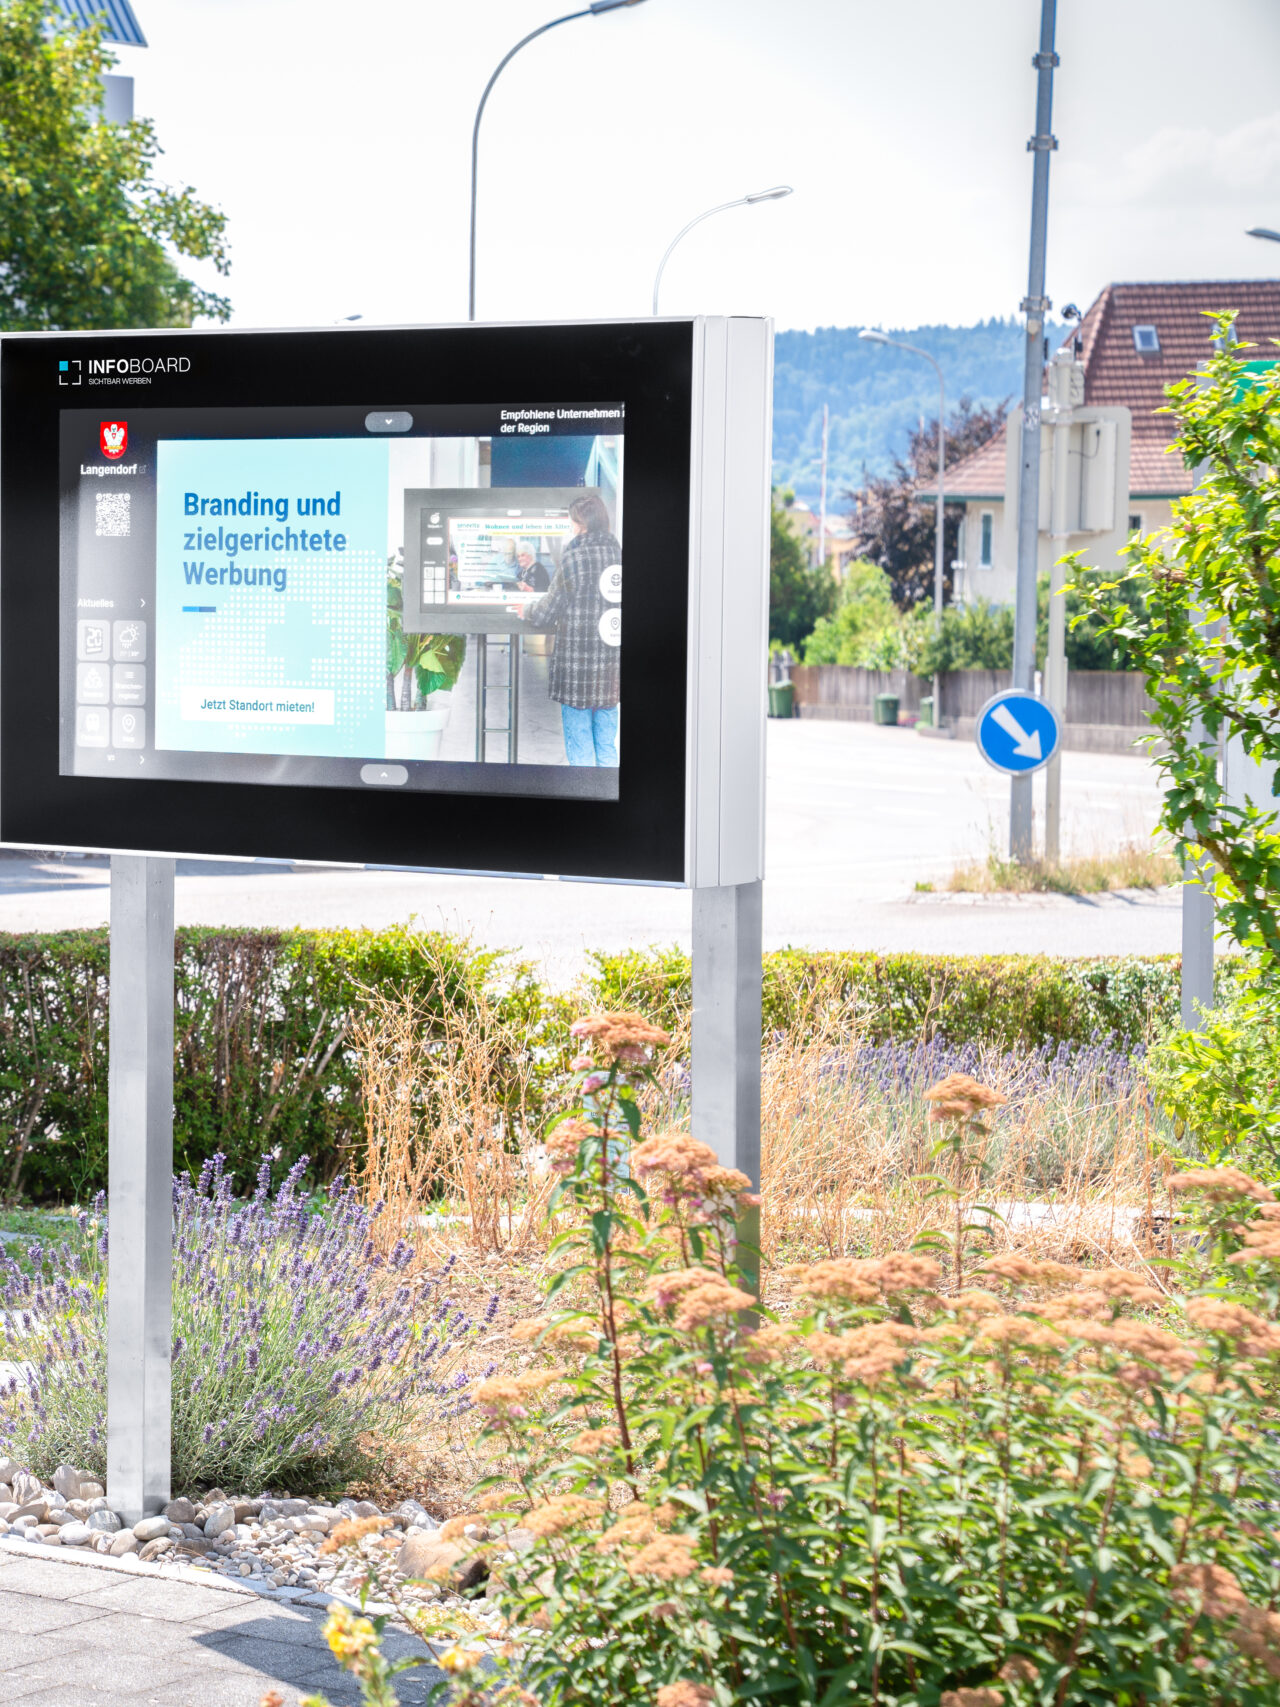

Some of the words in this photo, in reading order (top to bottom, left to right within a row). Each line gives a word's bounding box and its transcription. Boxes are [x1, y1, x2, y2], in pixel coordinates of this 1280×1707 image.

[88, 357, 191, 374] INFOBOARD
[501, 409, 556, 421] Empfohlene
[556, 408, 620, 419] Unternehmen
[500, 423, 516, 433] der
[518, 423, 550, 435] Region
[80, 464, 137, 477] Langendorf
[184, 491, 289, 522] Branding
[297, 491, 341, 516] und
[183, 526, 347, 557] zielgerichtete
[183, 561, 287, 592] Werbung
[201, 699, 226, 710] Jetzt
[229, 699, 274, 712] Standort
[276, 701, 315, 713] mieten!
